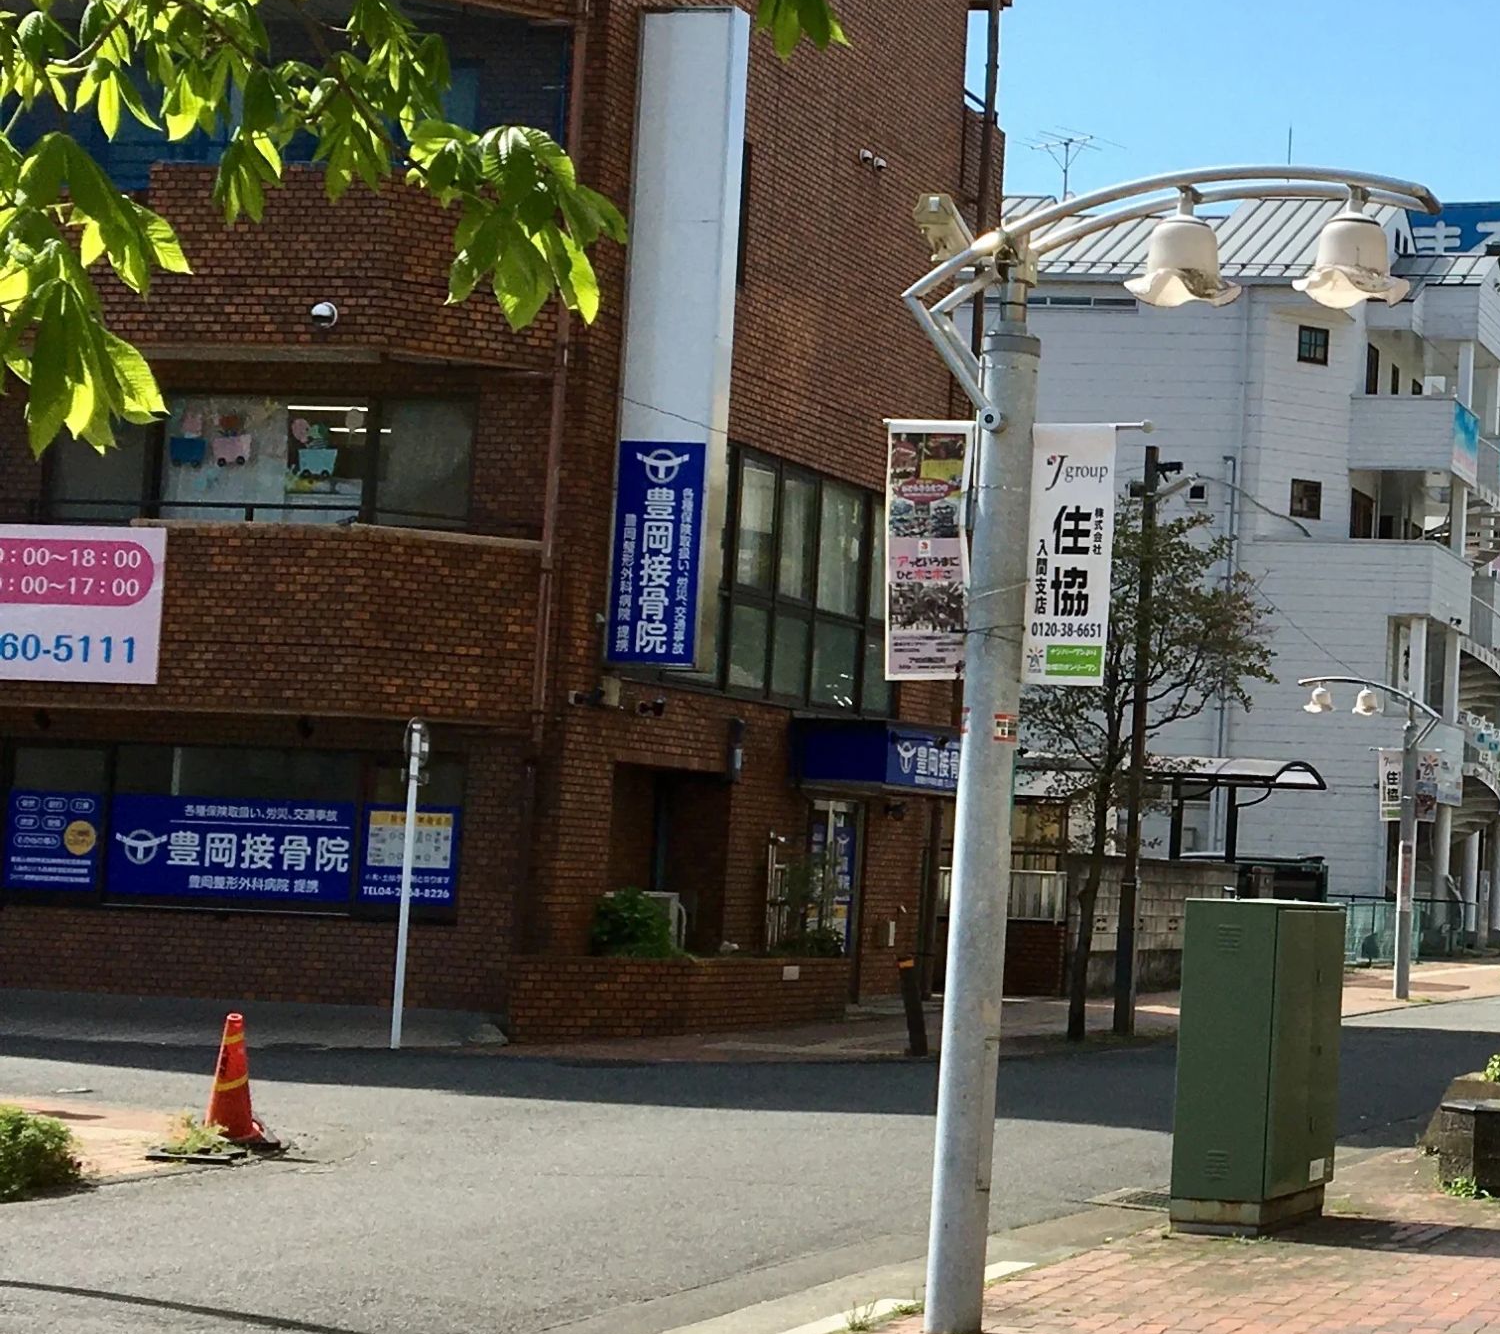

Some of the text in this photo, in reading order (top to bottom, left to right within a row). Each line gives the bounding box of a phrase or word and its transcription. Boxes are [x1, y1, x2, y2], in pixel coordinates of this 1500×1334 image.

[1092, 507, 1104, 555] 株式会社
[0, 547, 141, 568] :00~18:00
[635, 487, 676, 654] 豊岡接骨院
[1034, 538, 1048, 615] 入間支店
[1050, 505, 1092, 616] 住協
[0, 576, 139, 597] :00~17:00
[1031, 622, 1102, 638] 0120-38-6651
[166, 830, 350, 873] 豊岡接骨院
